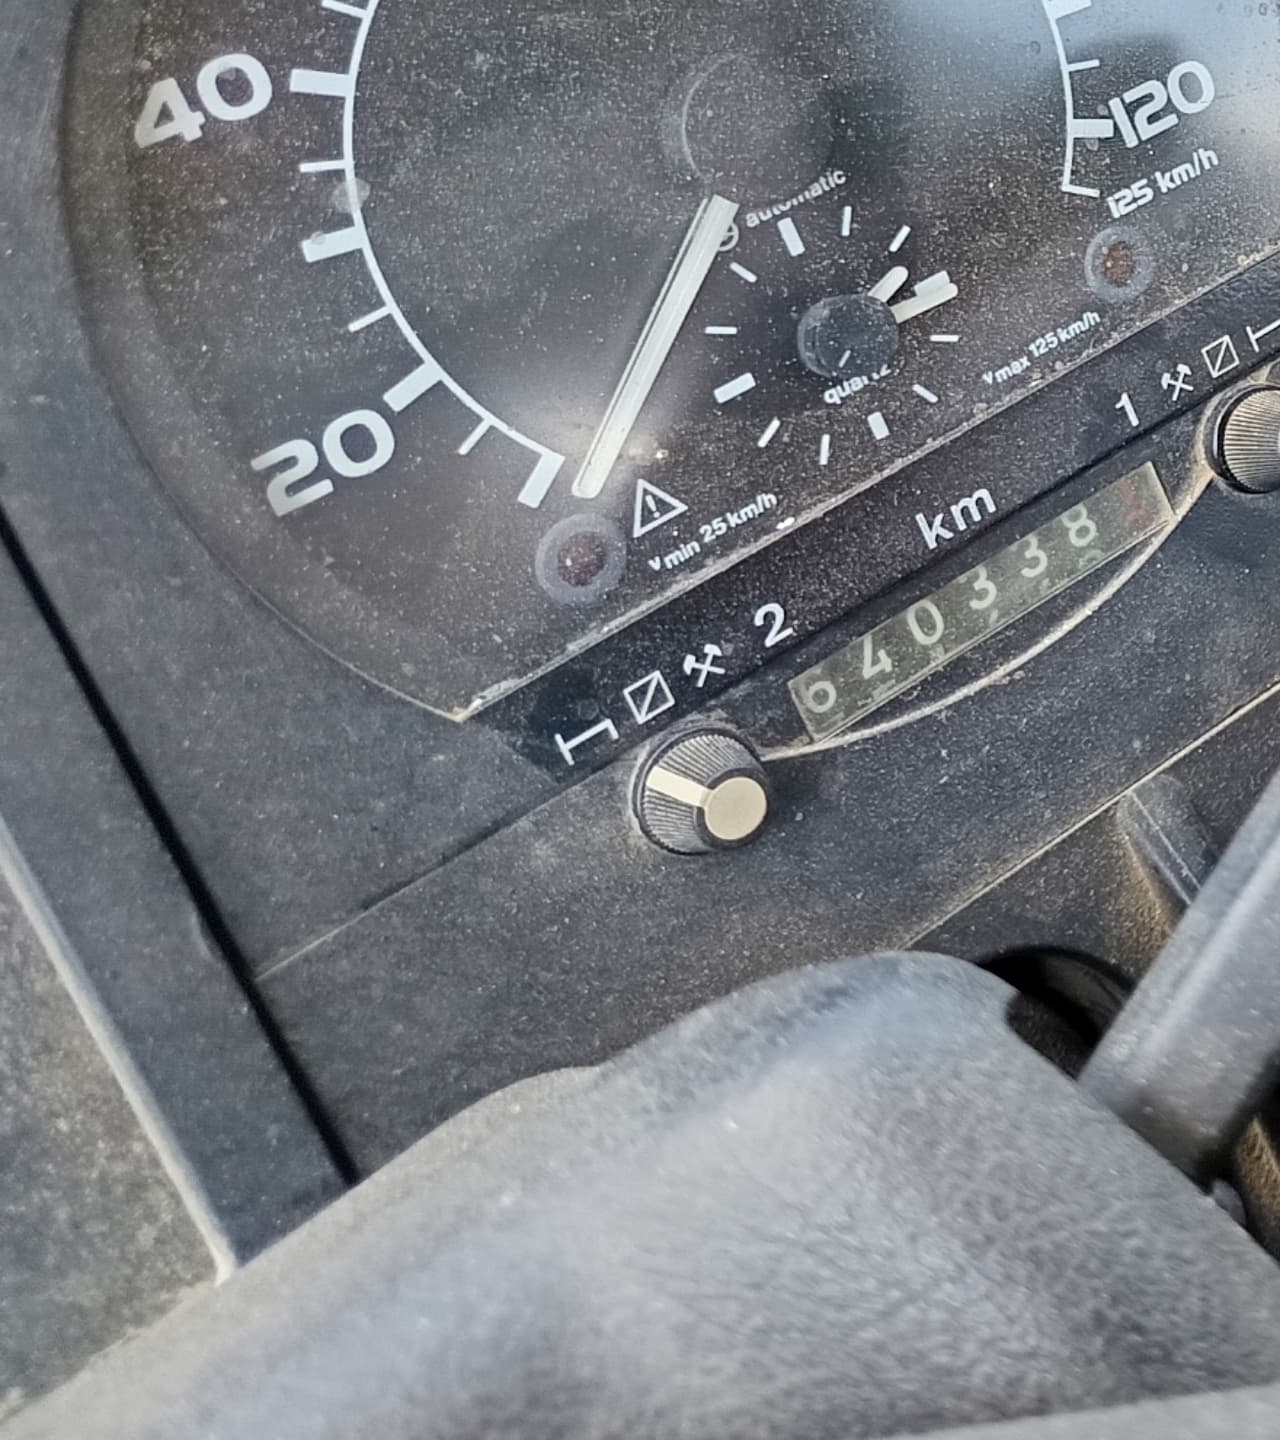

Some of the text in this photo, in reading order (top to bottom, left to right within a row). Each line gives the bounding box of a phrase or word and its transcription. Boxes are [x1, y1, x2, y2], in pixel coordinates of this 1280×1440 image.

[134, 53, 273, 149] 40
[1107, 60, 1216, 149] 120
[1106, 147, 1220, 220] 125 km/h
[1028, 332, 1060, 358] 125
[1056, 311, 1101, 343] km/h
[1114, 392, 1140, 427] 1
[250, 409, 396, 518] 20
[698, 516, 729, 543] 25
[725, 492, 778, 529] km/h
[915, 487, 998, 550] km
[753, 602, 794, 648] 2
